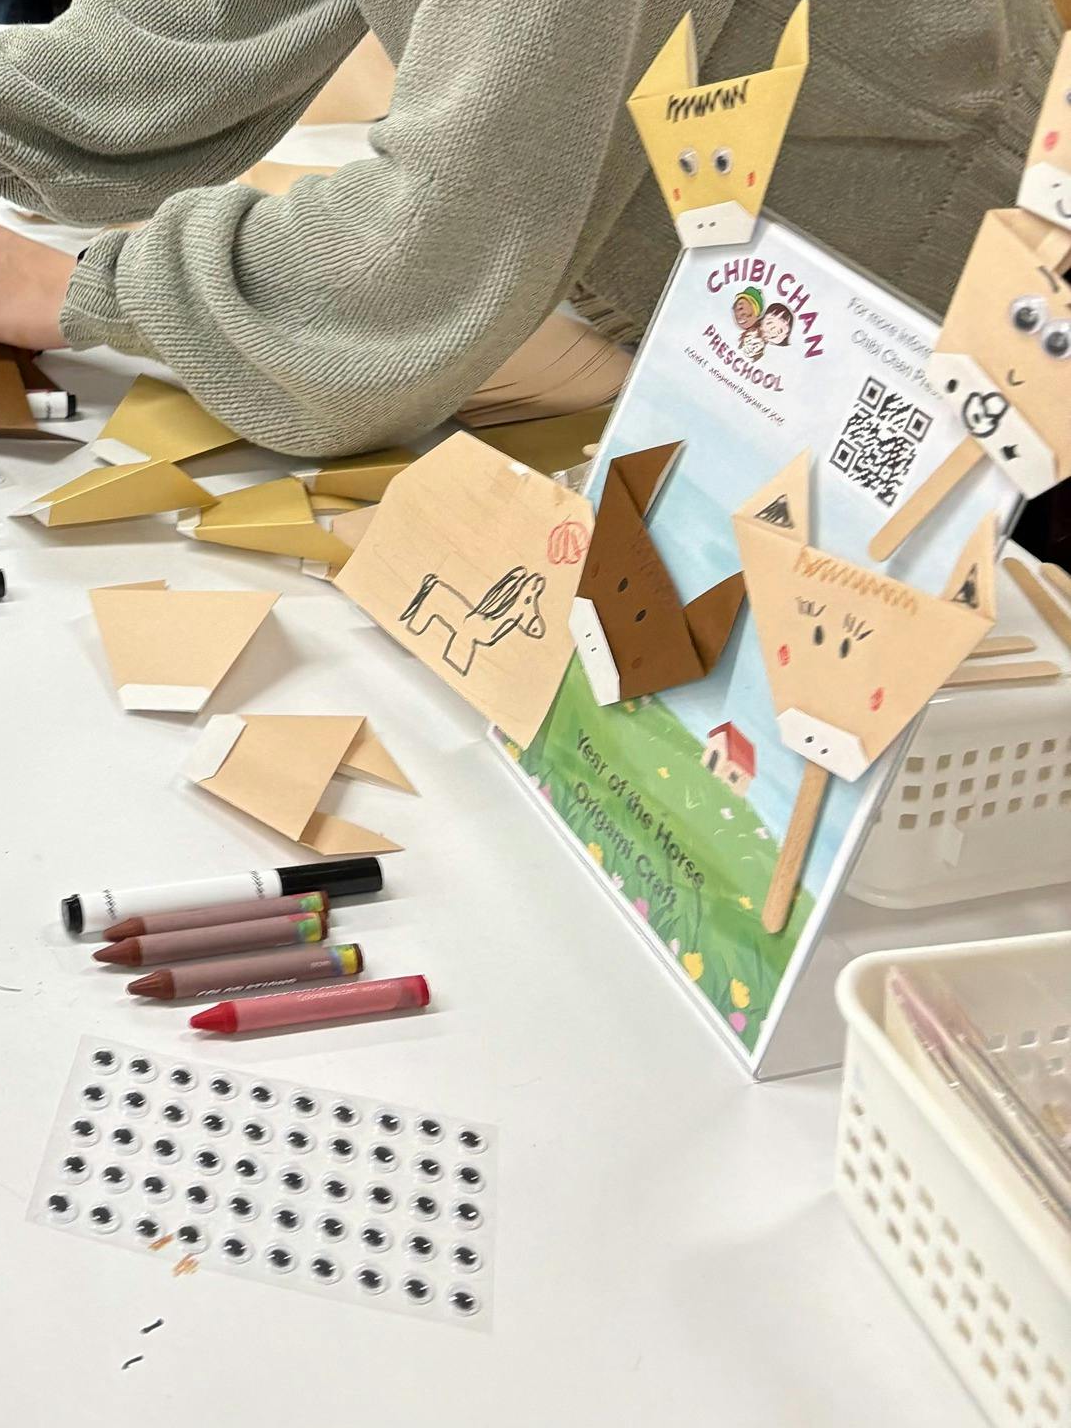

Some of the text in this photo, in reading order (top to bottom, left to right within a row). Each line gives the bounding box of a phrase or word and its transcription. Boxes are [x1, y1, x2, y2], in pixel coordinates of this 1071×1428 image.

[702, 324, 784, 392] PRESCHOOL
[707, 258, 824, 359] CHIBI CHAN
[574, 781, 678, 912] Origami Craft
[577, 728, 706, 890] Year of the Horse
